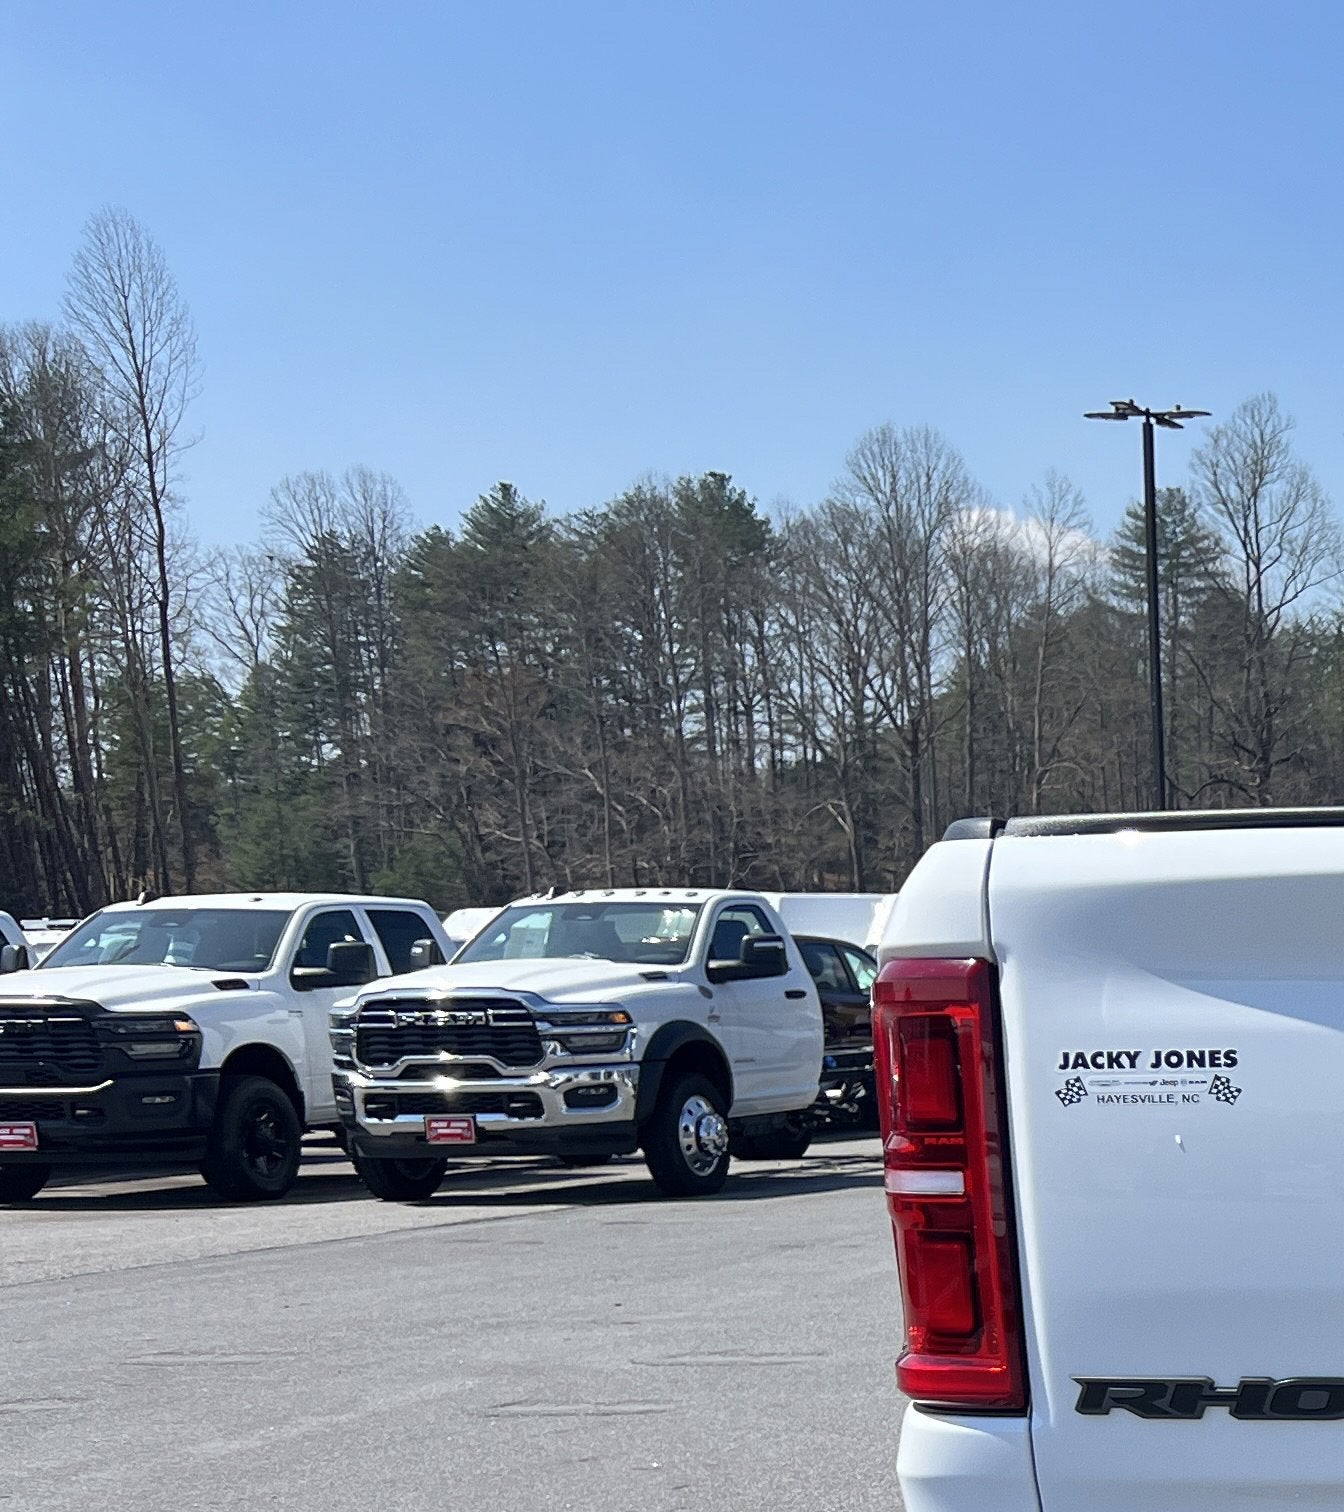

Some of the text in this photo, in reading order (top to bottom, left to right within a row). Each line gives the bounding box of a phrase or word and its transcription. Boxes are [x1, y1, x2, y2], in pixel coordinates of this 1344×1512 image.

[1058, 1049, 1239, 1070] JACKY JONES
[1096, 1094, 1200, 1105] HAYESVILLE, NC
